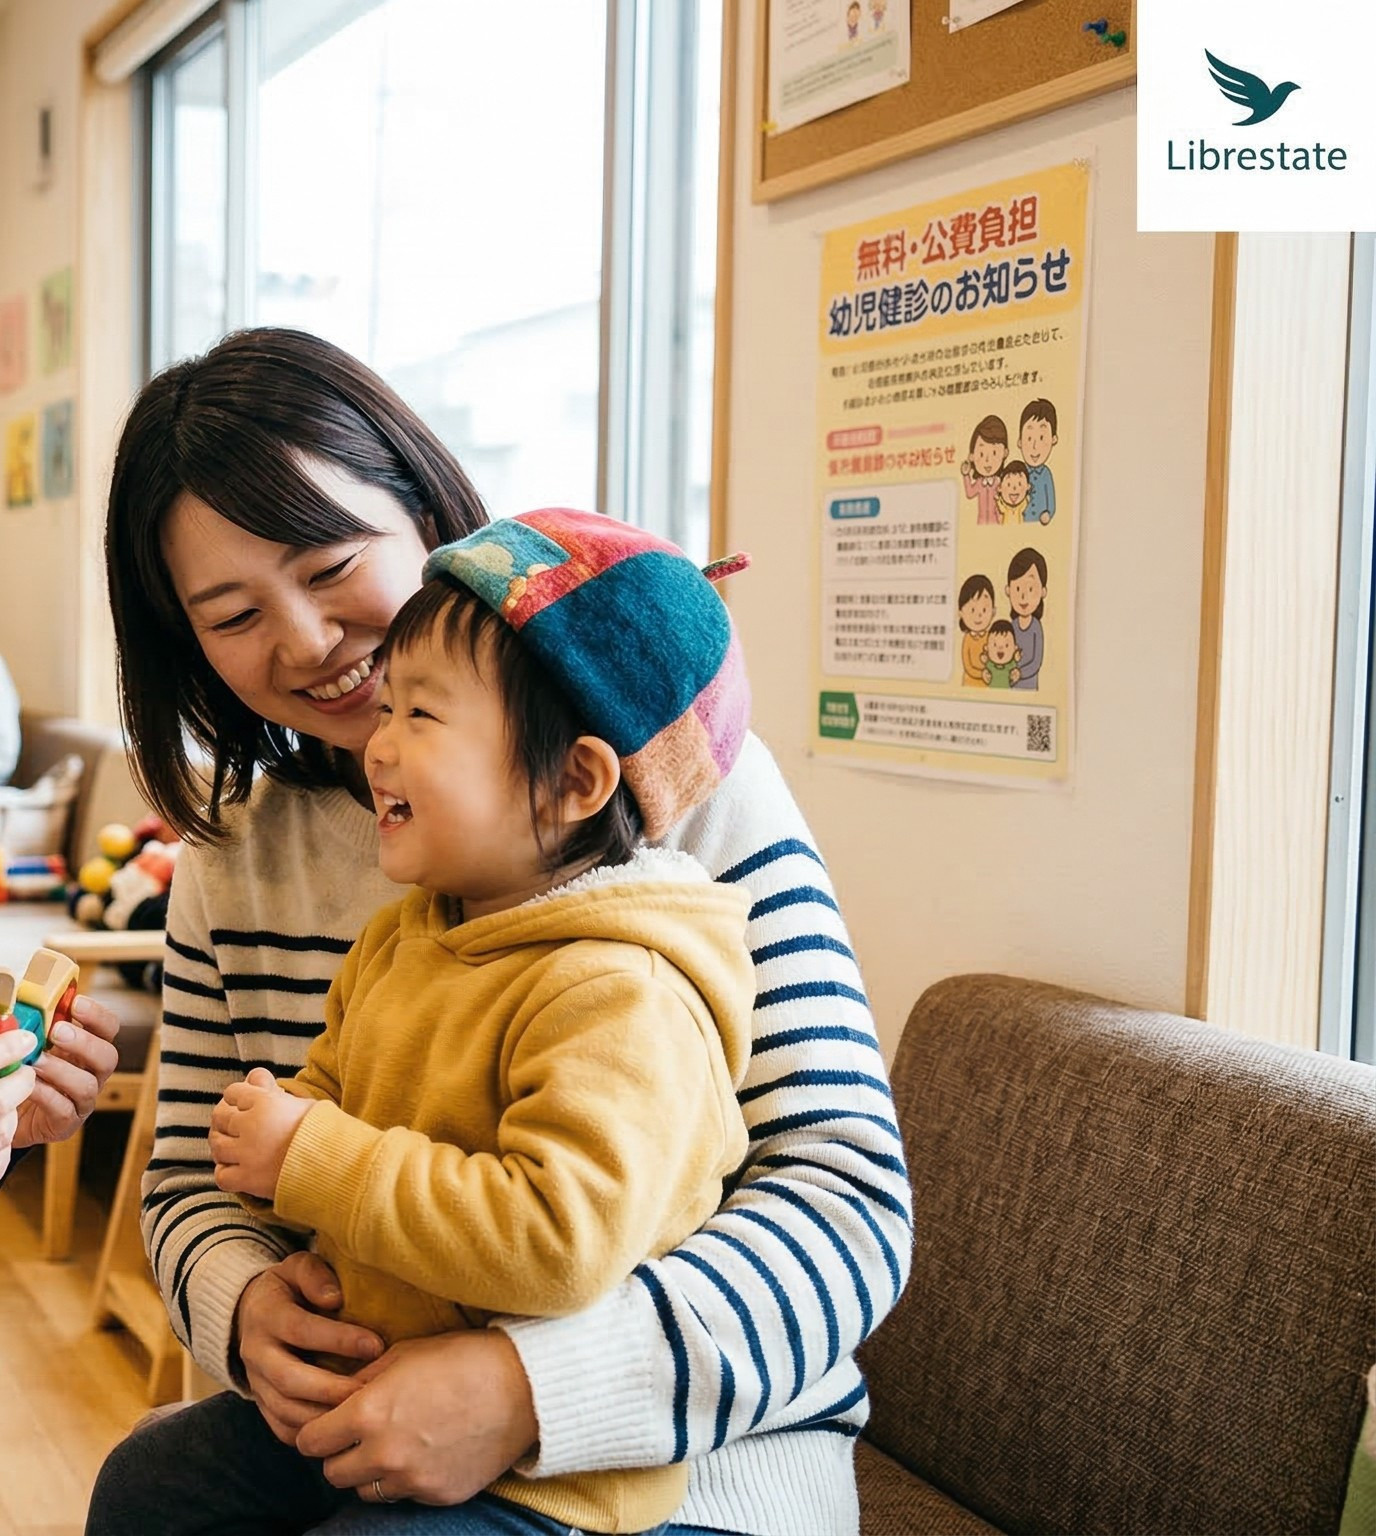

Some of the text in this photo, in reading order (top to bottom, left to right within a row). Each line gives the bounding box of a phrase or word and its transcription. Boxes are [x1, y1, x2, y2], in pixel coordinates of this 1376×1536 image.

[856, 195, 1038, 281] 無料・公費負担
[828, 248, 1071, 337] 幼児健診のお知らせ
